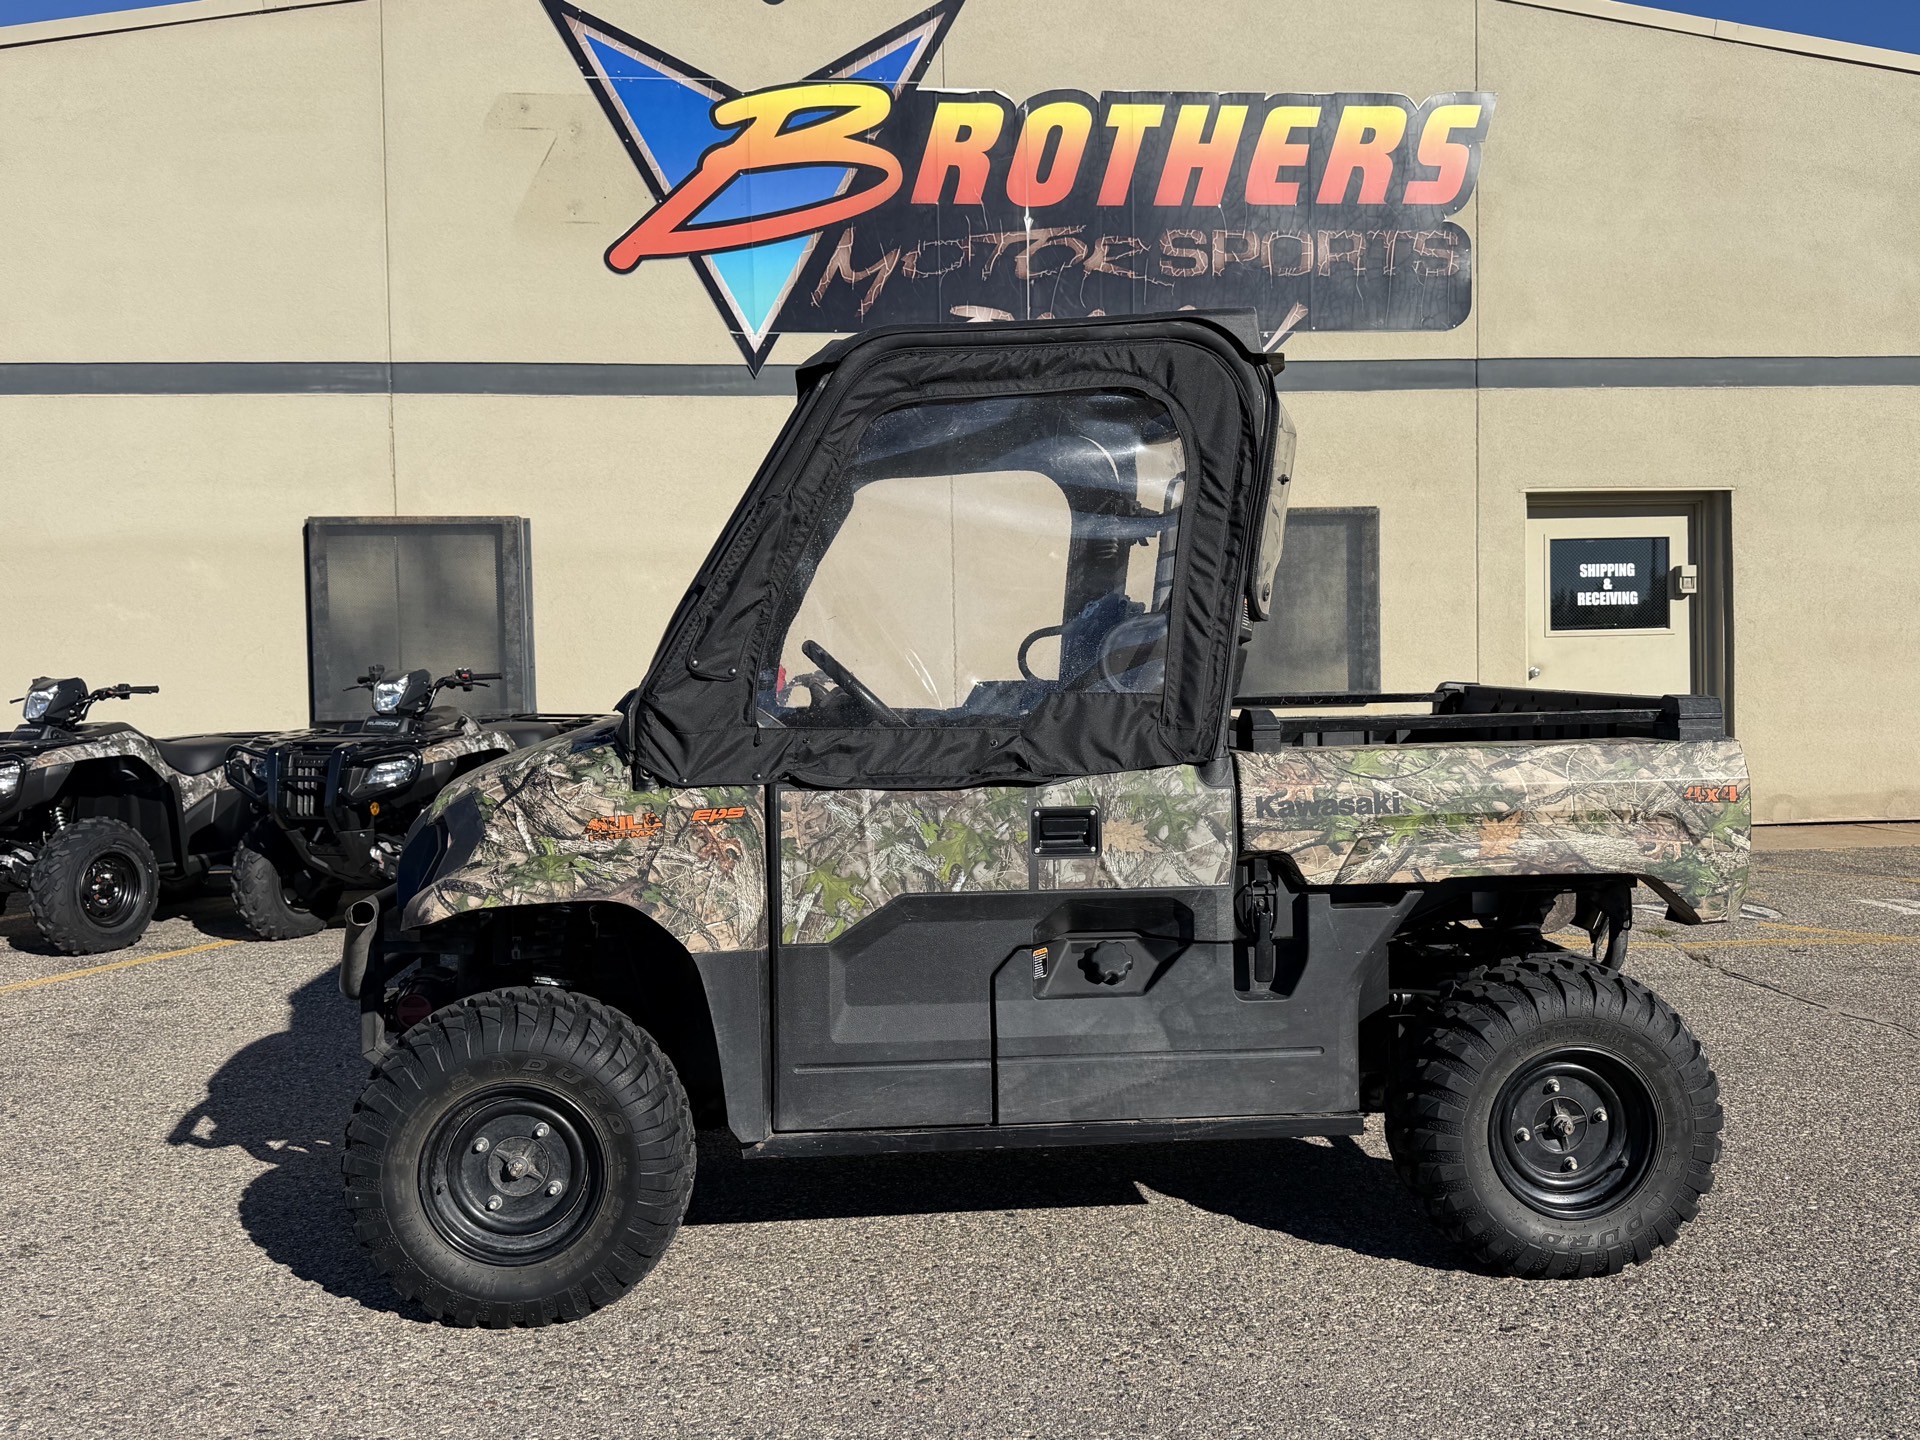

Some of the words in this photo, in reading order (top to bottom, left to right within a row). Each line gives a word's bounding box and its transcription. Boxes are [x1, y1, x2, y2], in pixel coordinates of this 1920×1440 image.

[605, 82, 1483, 272] BROTHERS
[1579, 562, 1636, 578] SHIPPING
[1602, 577, 1613, 590] &
[1577, 590, 1639, 606] RECEIVING
[366, 719, 401, 727] RUBICON
[1255, 790, 1401, 819] Kawasaki
[691, 807, 746, 824] EPS
[518, 1057, 627, 1135] DURO
[1540, 1212, 1645, 1249] DURO
